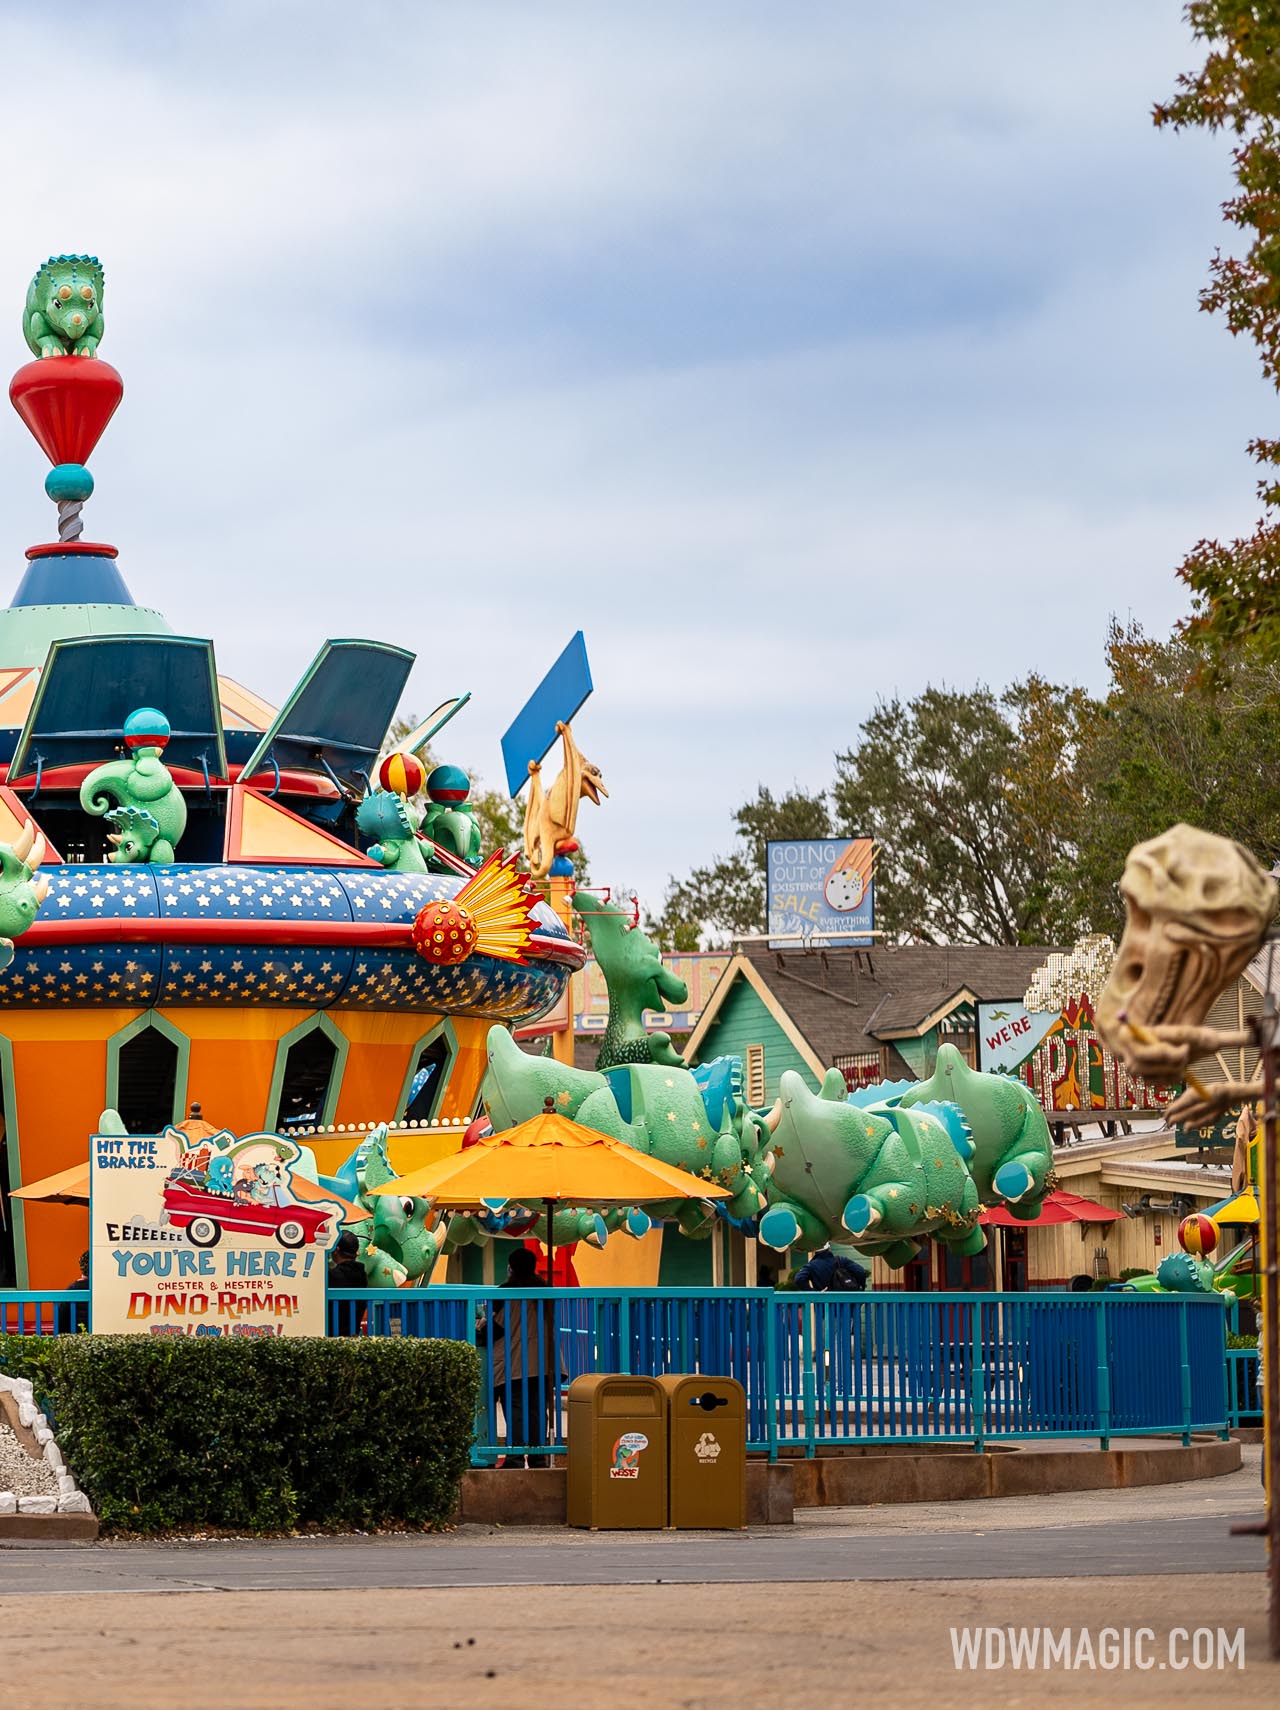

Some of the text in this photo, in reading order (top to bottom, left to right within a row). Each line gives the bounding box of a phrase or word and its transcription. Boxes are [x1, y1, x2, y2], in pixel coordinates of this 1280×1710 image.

[771, 844, 836, 865] GOING
[774, 866, 825, 882] OUT OF
[771, 881, 824, 892] EXISTENCE
[772, 893, 822, 920] SALE
[985, 1015, 1032, 1050] WE'RE
[97, 1141, 158, 1155] HIT THE
[97, 1155, 167, 1169] BRAKES...
[112, 1250, 216, 1277] YOU'RE
[157, 1281, 274, 1290] CHESTER & HESTER'S
[127, 1292, 300, 1320] DINO-RAMA!
